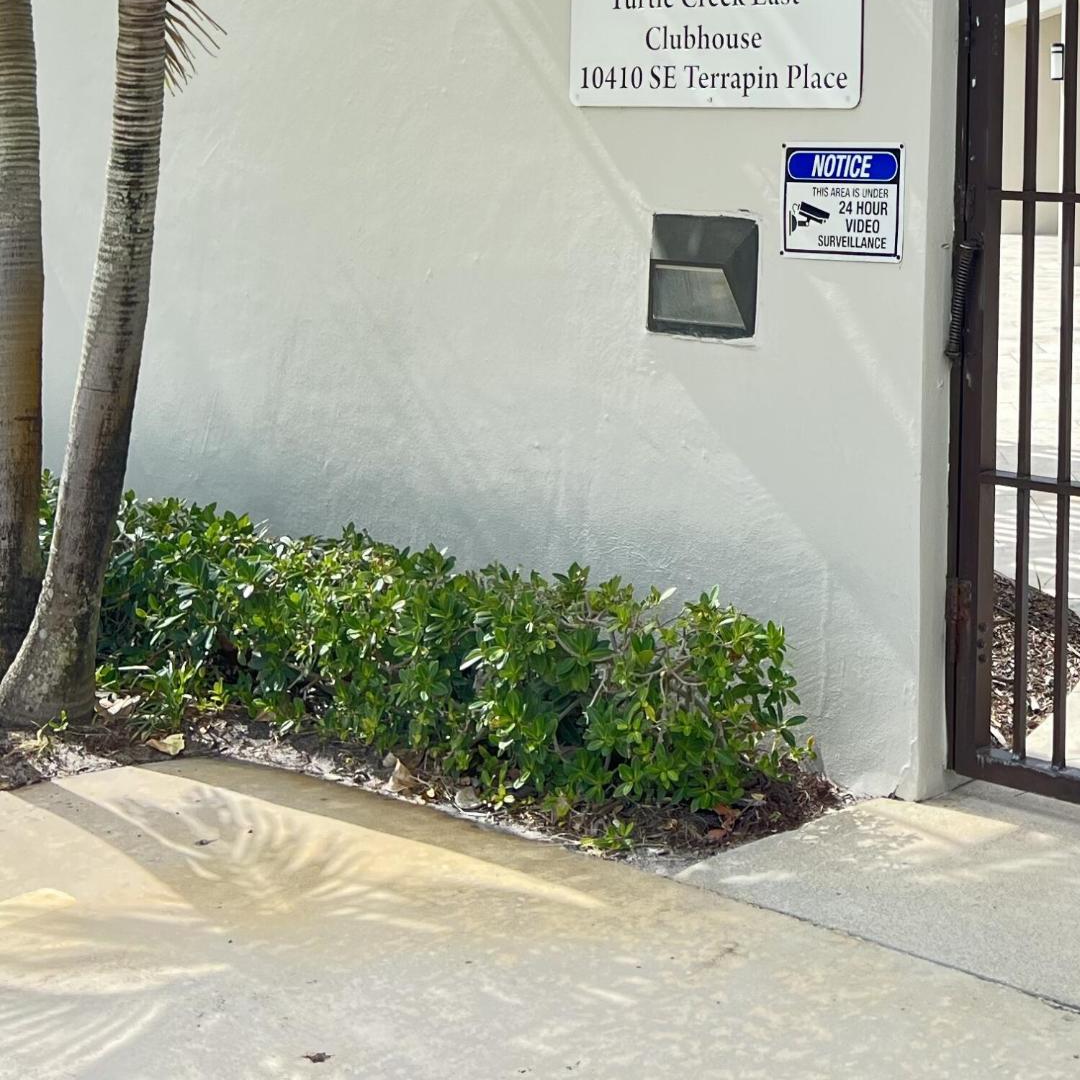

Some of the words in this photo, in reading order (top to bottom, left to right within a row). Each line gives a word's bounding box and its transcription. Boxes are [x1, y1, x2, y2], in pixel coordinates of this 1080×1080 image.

[645, 25, 762, 50] Clubhouse
[580, 66, 643, 89] 10410
[649, 65, 677, 89] SE
[684, 65, 778, 97] Terrapin
[787, 63, 848, 89] Place
[811, 154, 873, 178] NOTICE
[812, 187, 829, 197] THIS
[830, 187, 850, 198] AREA
[852, 188, 860, 198] IS
[862, 188, 889, 199] UNDER
[839, 201, 852, 215] 24
[856, 201, 888, 216] HOUR
[845, 219, 880, 234] VIDEO
[818, 235, 886, 249] SURVEILLANCE
